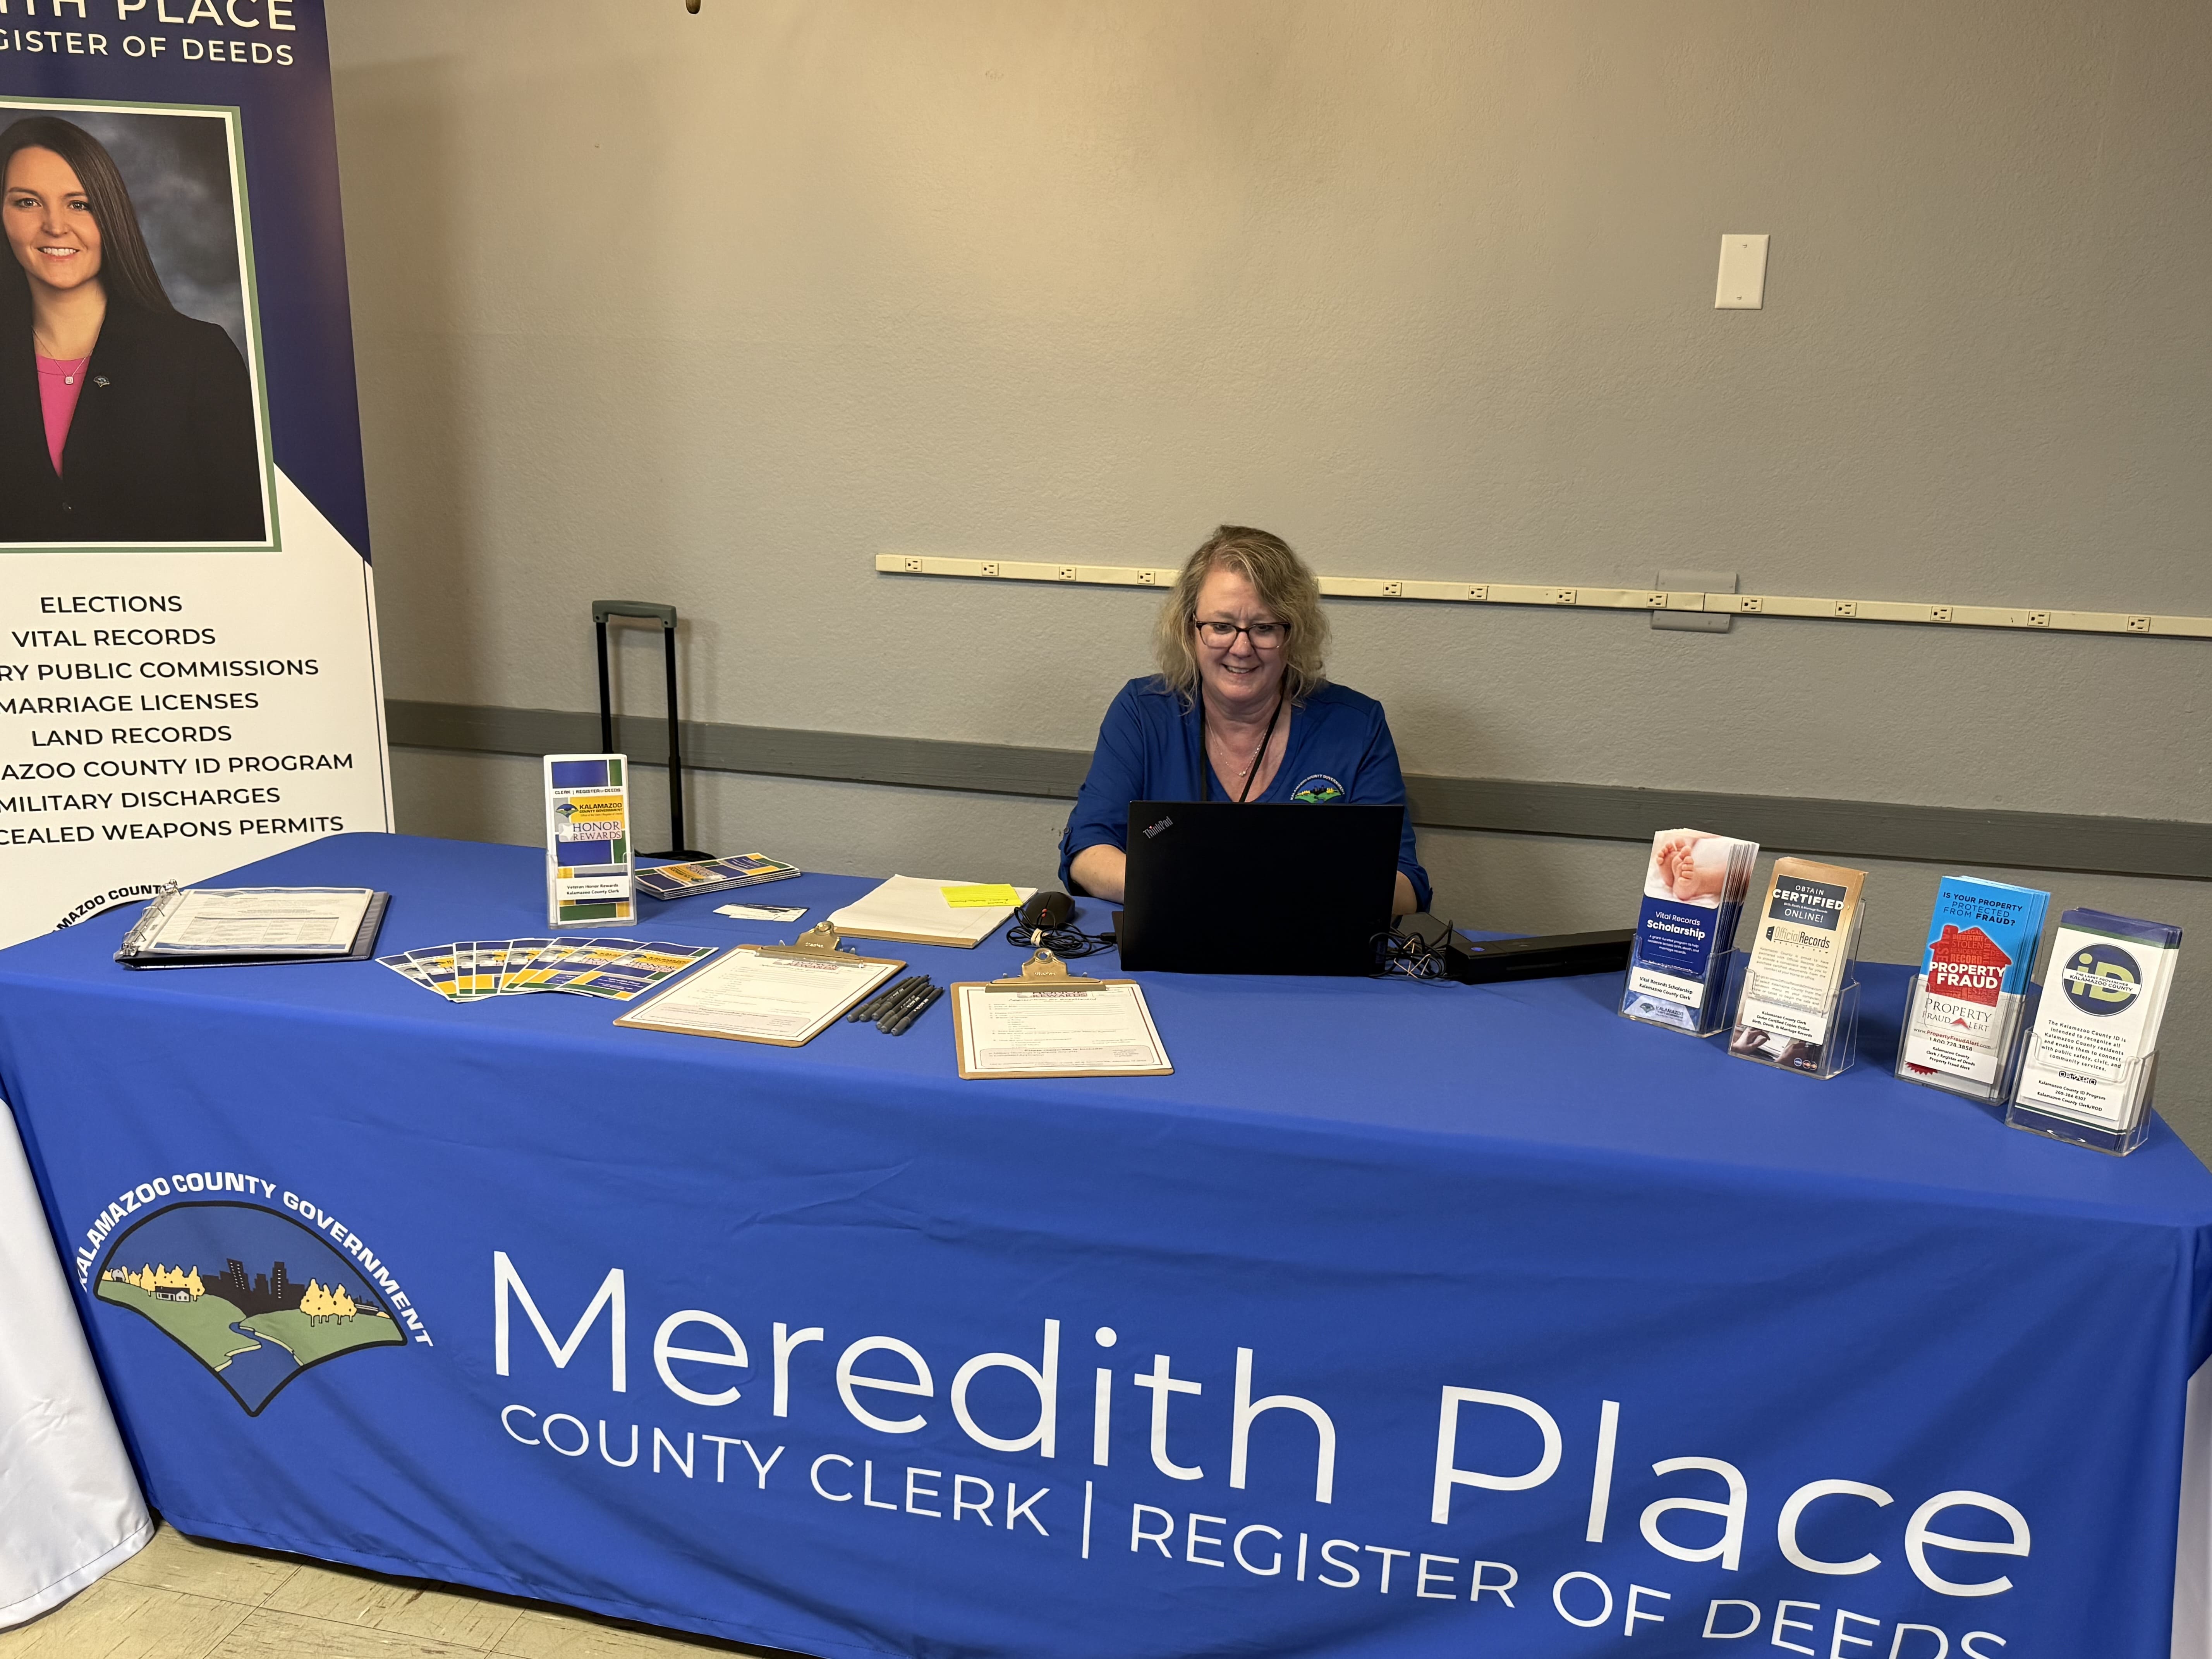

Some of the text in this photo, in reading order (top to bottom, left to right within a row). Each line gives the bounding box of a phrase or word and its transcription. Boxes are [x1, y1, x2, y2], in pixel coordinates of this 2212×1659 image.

[118, 0, 295, 31] PLACE
[123, 36, 166, 58] OF
[182, 39, 293, 65] DEEDS
[40, 596, 182, 613] ELECTIONS
[12, 629, 216, 647] VITAL RECORDS
[38, 663, 131, 680] PUBLIC
[140, 659, 319, 678] COMMISSIONS
[0, 693, 259, 714] MARRIAGE LICENSES
[32, 726, 232, 746] LAND RECORDS
[2, 754, 353, 780] AZOO COUNTY ID PROGRAM
[0, 788, 280, 813] MILITARY DISCHARGES
[102, 821, 232, 841] WEAPONS
[240, 816, 343, 835] PERMITS
[573, 821, 620, 832] HONOR
[1143, 816, 1173, 838] ThinkPad
[573, 831, 621, 841] REWARDS
[108, 885, 166, 900] COUNT
[1795, 885, 1824, 895] OBTAIN
[1772, 889, 1844, 910] CERTIFIED
[1954, 893, 1976, 903] YOUR
[1978, 898, 2023, 912] PROPERTY
[1784, 908, 1824, 923] ONLINE!
[1943, 907, 2015, 926] FROM FRAUD?
[1952, 901, 2009, 917] PROTECTED
[1656, 911, 1700, 926] Vital Records
[1647, 919, 1705, 941] Scholarship
[1775, 926, 1830, 948] OfficialRecords
[1952, 940, 1984, 949] STOLEN
[1950, 954, 1982, 964] RECORD
[1930, 962, 2005, 977] PROPERTY
[1668, 984, 1693, 994] Scholarship
[1937, 972, 1998, 989] FRAUD
[2070, 974, 2133, 992] KALAMAZOO COUNTY
[1639, 983, 1662, 993] Kalamazoo
[1663, 989, 1679, 998] County
[1922, 1011, 1951, 1024] FRAUD
[1925, 998, 1992, 1022] PROPERTY
[1913, 1028, 1991, 1049] www.PropertyFraudAlert.com
[2060, 1023, 2090, 1034] Kalamazoo
[2092, 1030, 2112, 1039] County
[1929, 1037, 1972, 1051] 1800.728.3858
[2045, 1032, 2124, 1056] Kalamazoo County residents
[2084, 1036, 2112, 1045] recognize
[1933, 1047, 1954, 1055] Kalamazoo
[2074, 1053, 2092, 1061] safety,
[2099, 1053, 2121, 1062] connect
[2049, 1054, 2106, 1072] community services.
[2037, 1091, 2061, 1101] Kalamazoo
[2039, 1080, 2062, 1089] Kalamazoo
[2086, 1092, 2106, 1100] Program
[172, 1172, 276, 1199] COUNTY
[283, 1191, 434, 1347] GOVERNMENT
[494, 1251, 2031, 1597] Meredith Place
[500, 1403, 784, 1490] COUNTY
[811, 1454, 1050, 1537] CLERK
[1131, 1504, 1519, 1608] REGISTER
[1553, 1571, 1672, 1637] OF
[1702, 1600, 2006, 1659] DEEDS
